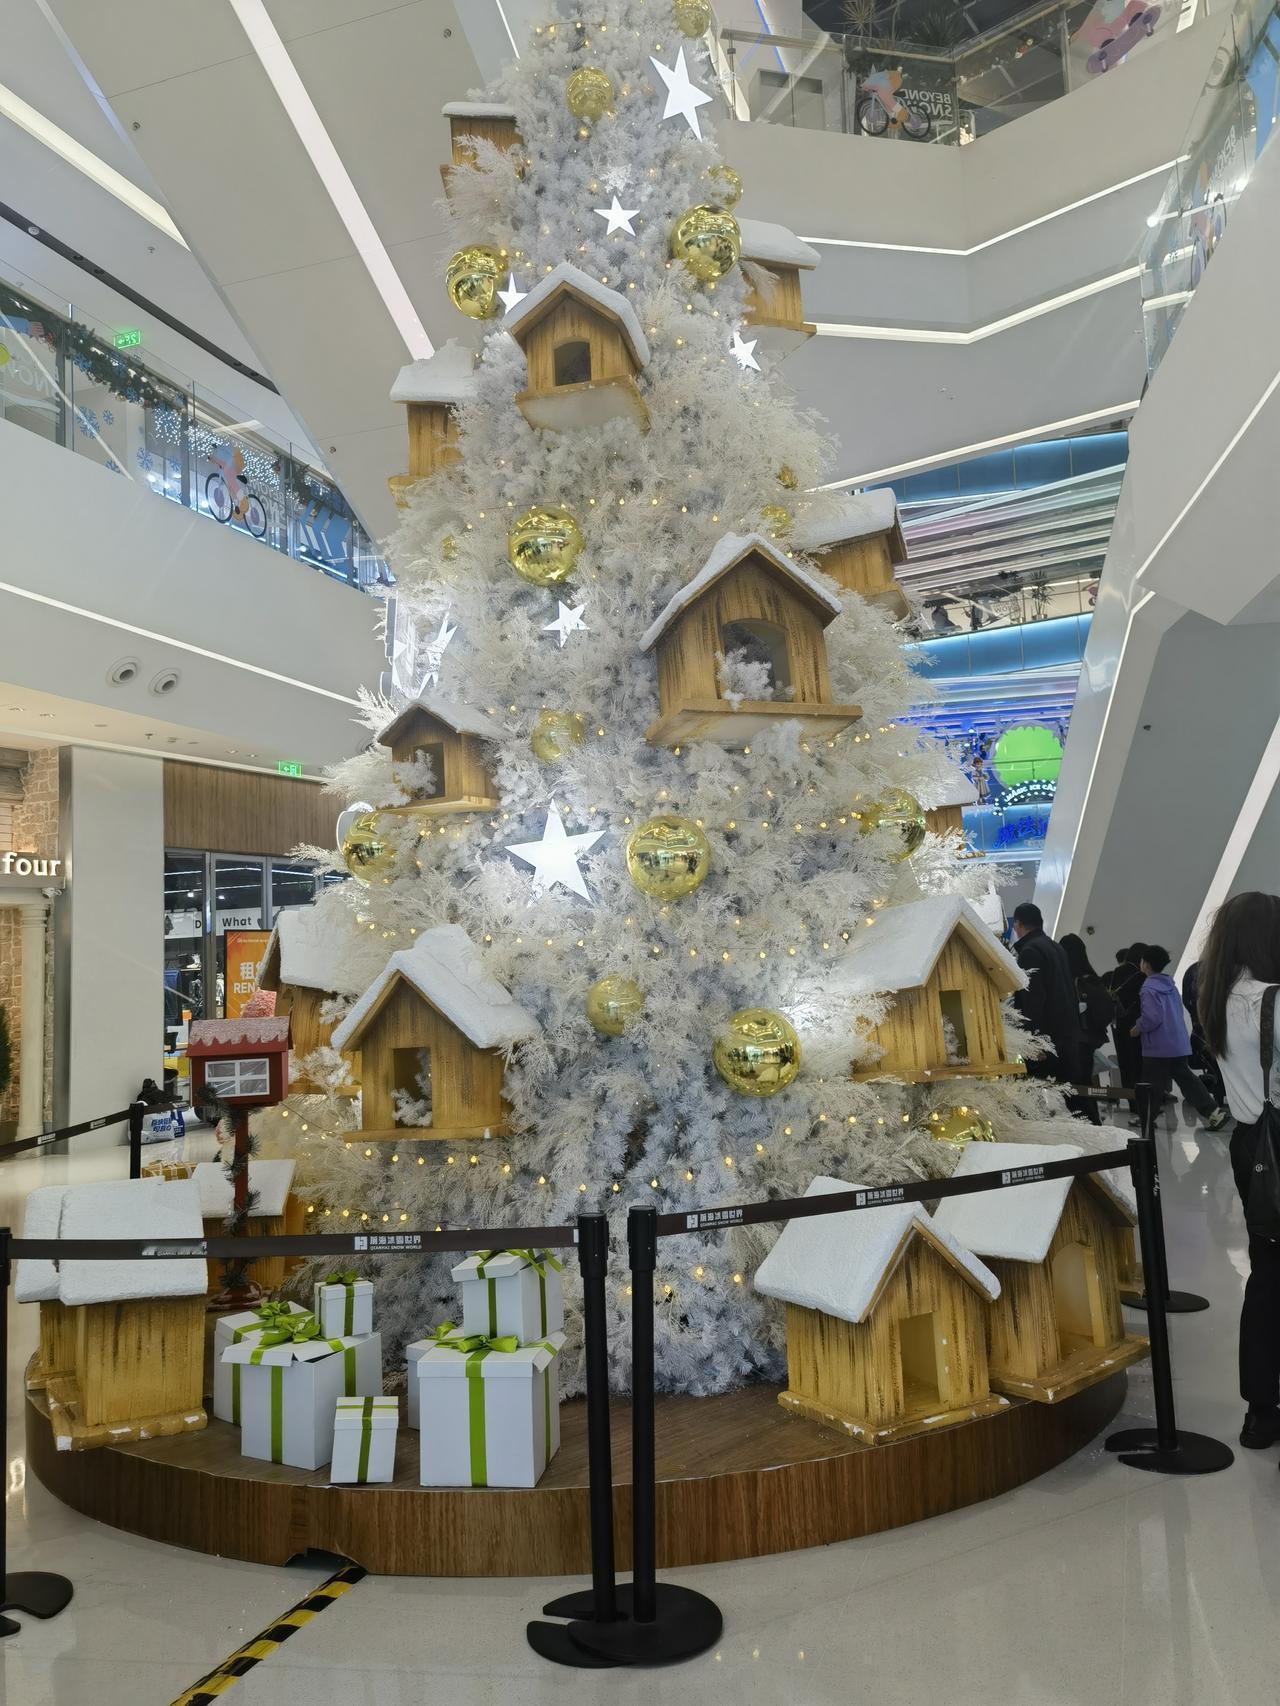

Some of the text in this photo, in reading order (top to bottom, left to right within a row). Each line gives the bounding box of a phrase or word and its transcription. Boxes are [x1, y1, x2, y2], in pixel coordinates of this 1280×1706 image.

[2, 851, 62, 876] four
[222, 917, 252, 928] What
[233, 982, 257, 994] REN
